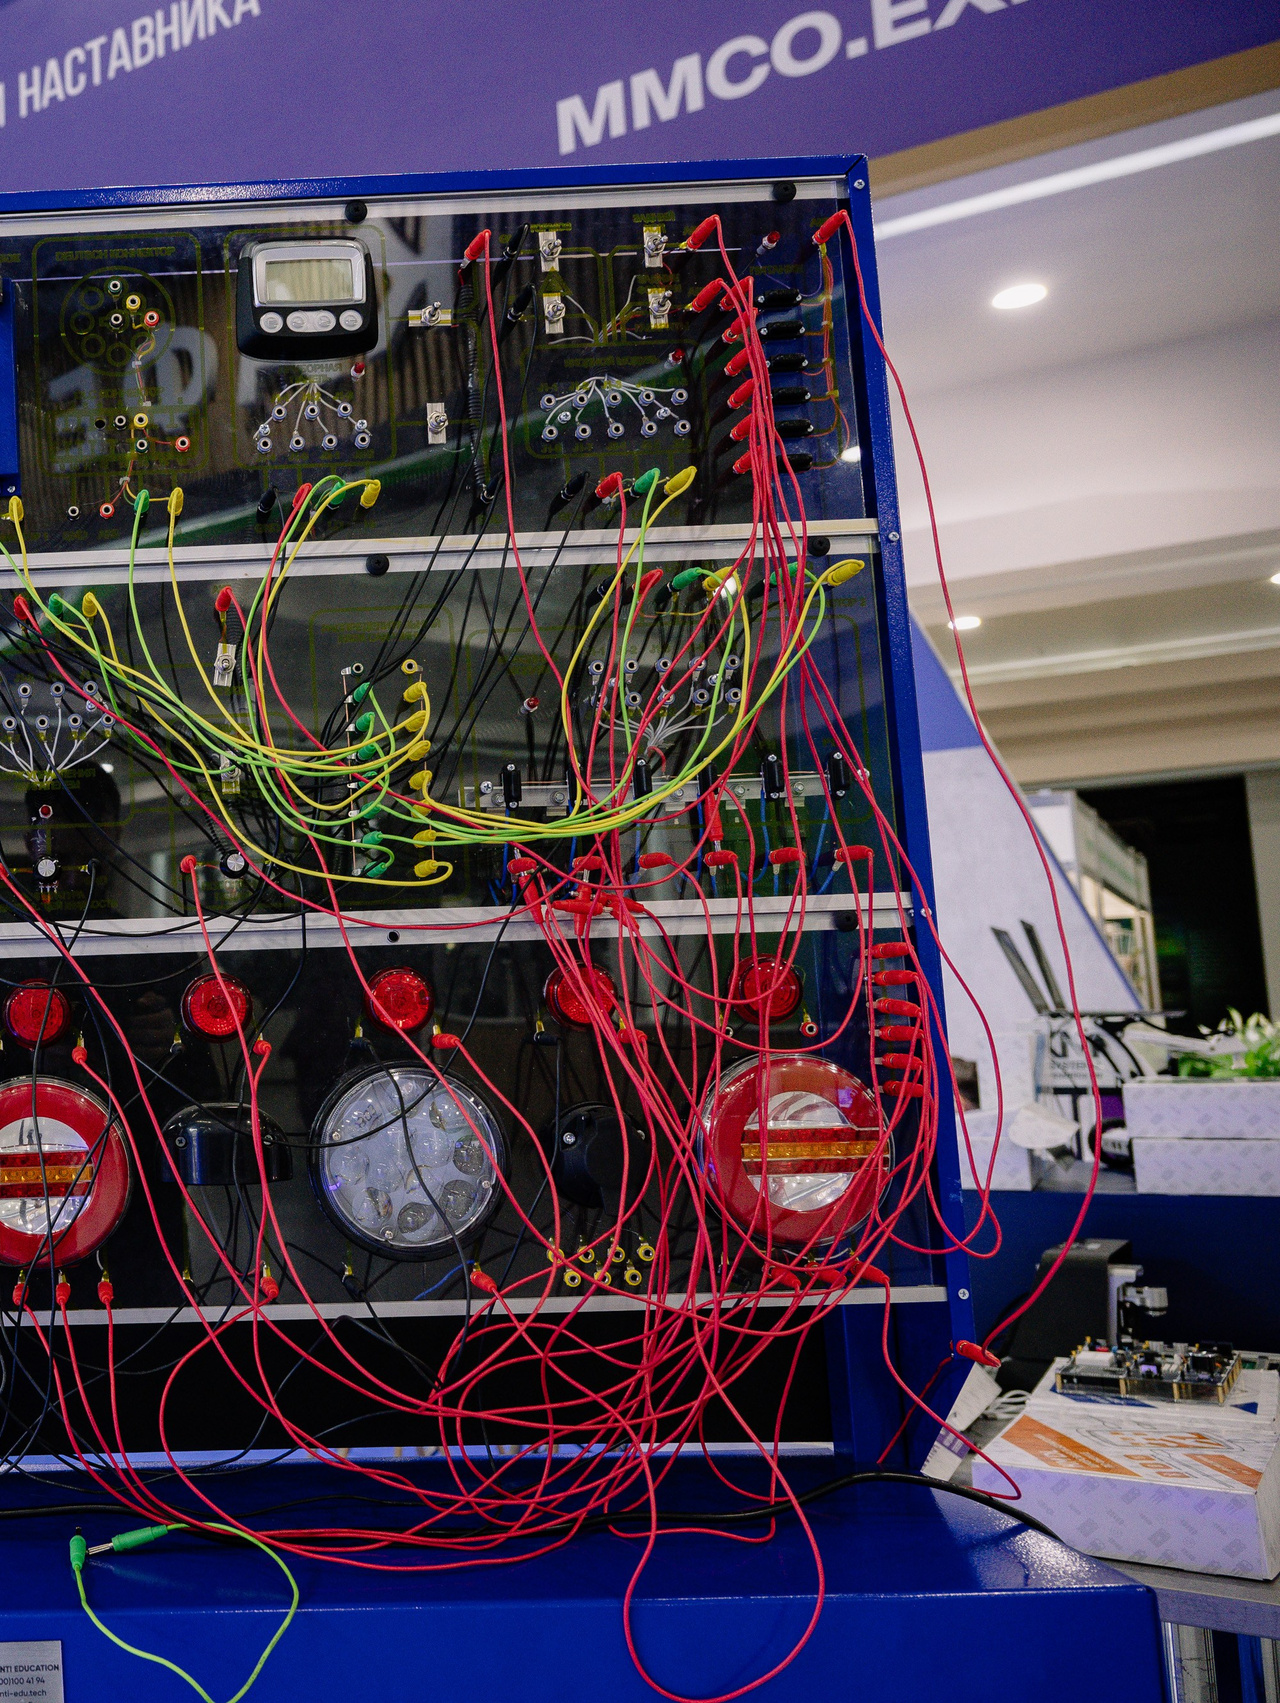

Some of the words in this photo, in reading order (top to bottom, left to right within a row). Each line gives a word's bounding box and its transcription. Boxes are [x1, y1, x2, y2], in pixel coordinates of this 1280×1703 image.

[18, 0, 262, 118] НАСТАВНИКА
[555, 0, 1028, 156] MMCO.E
[14, 1664, 60, 1673] EDUCATION
[25, 1676, 35, 1684] 41
[36, 1676, 45, 1684] 94
